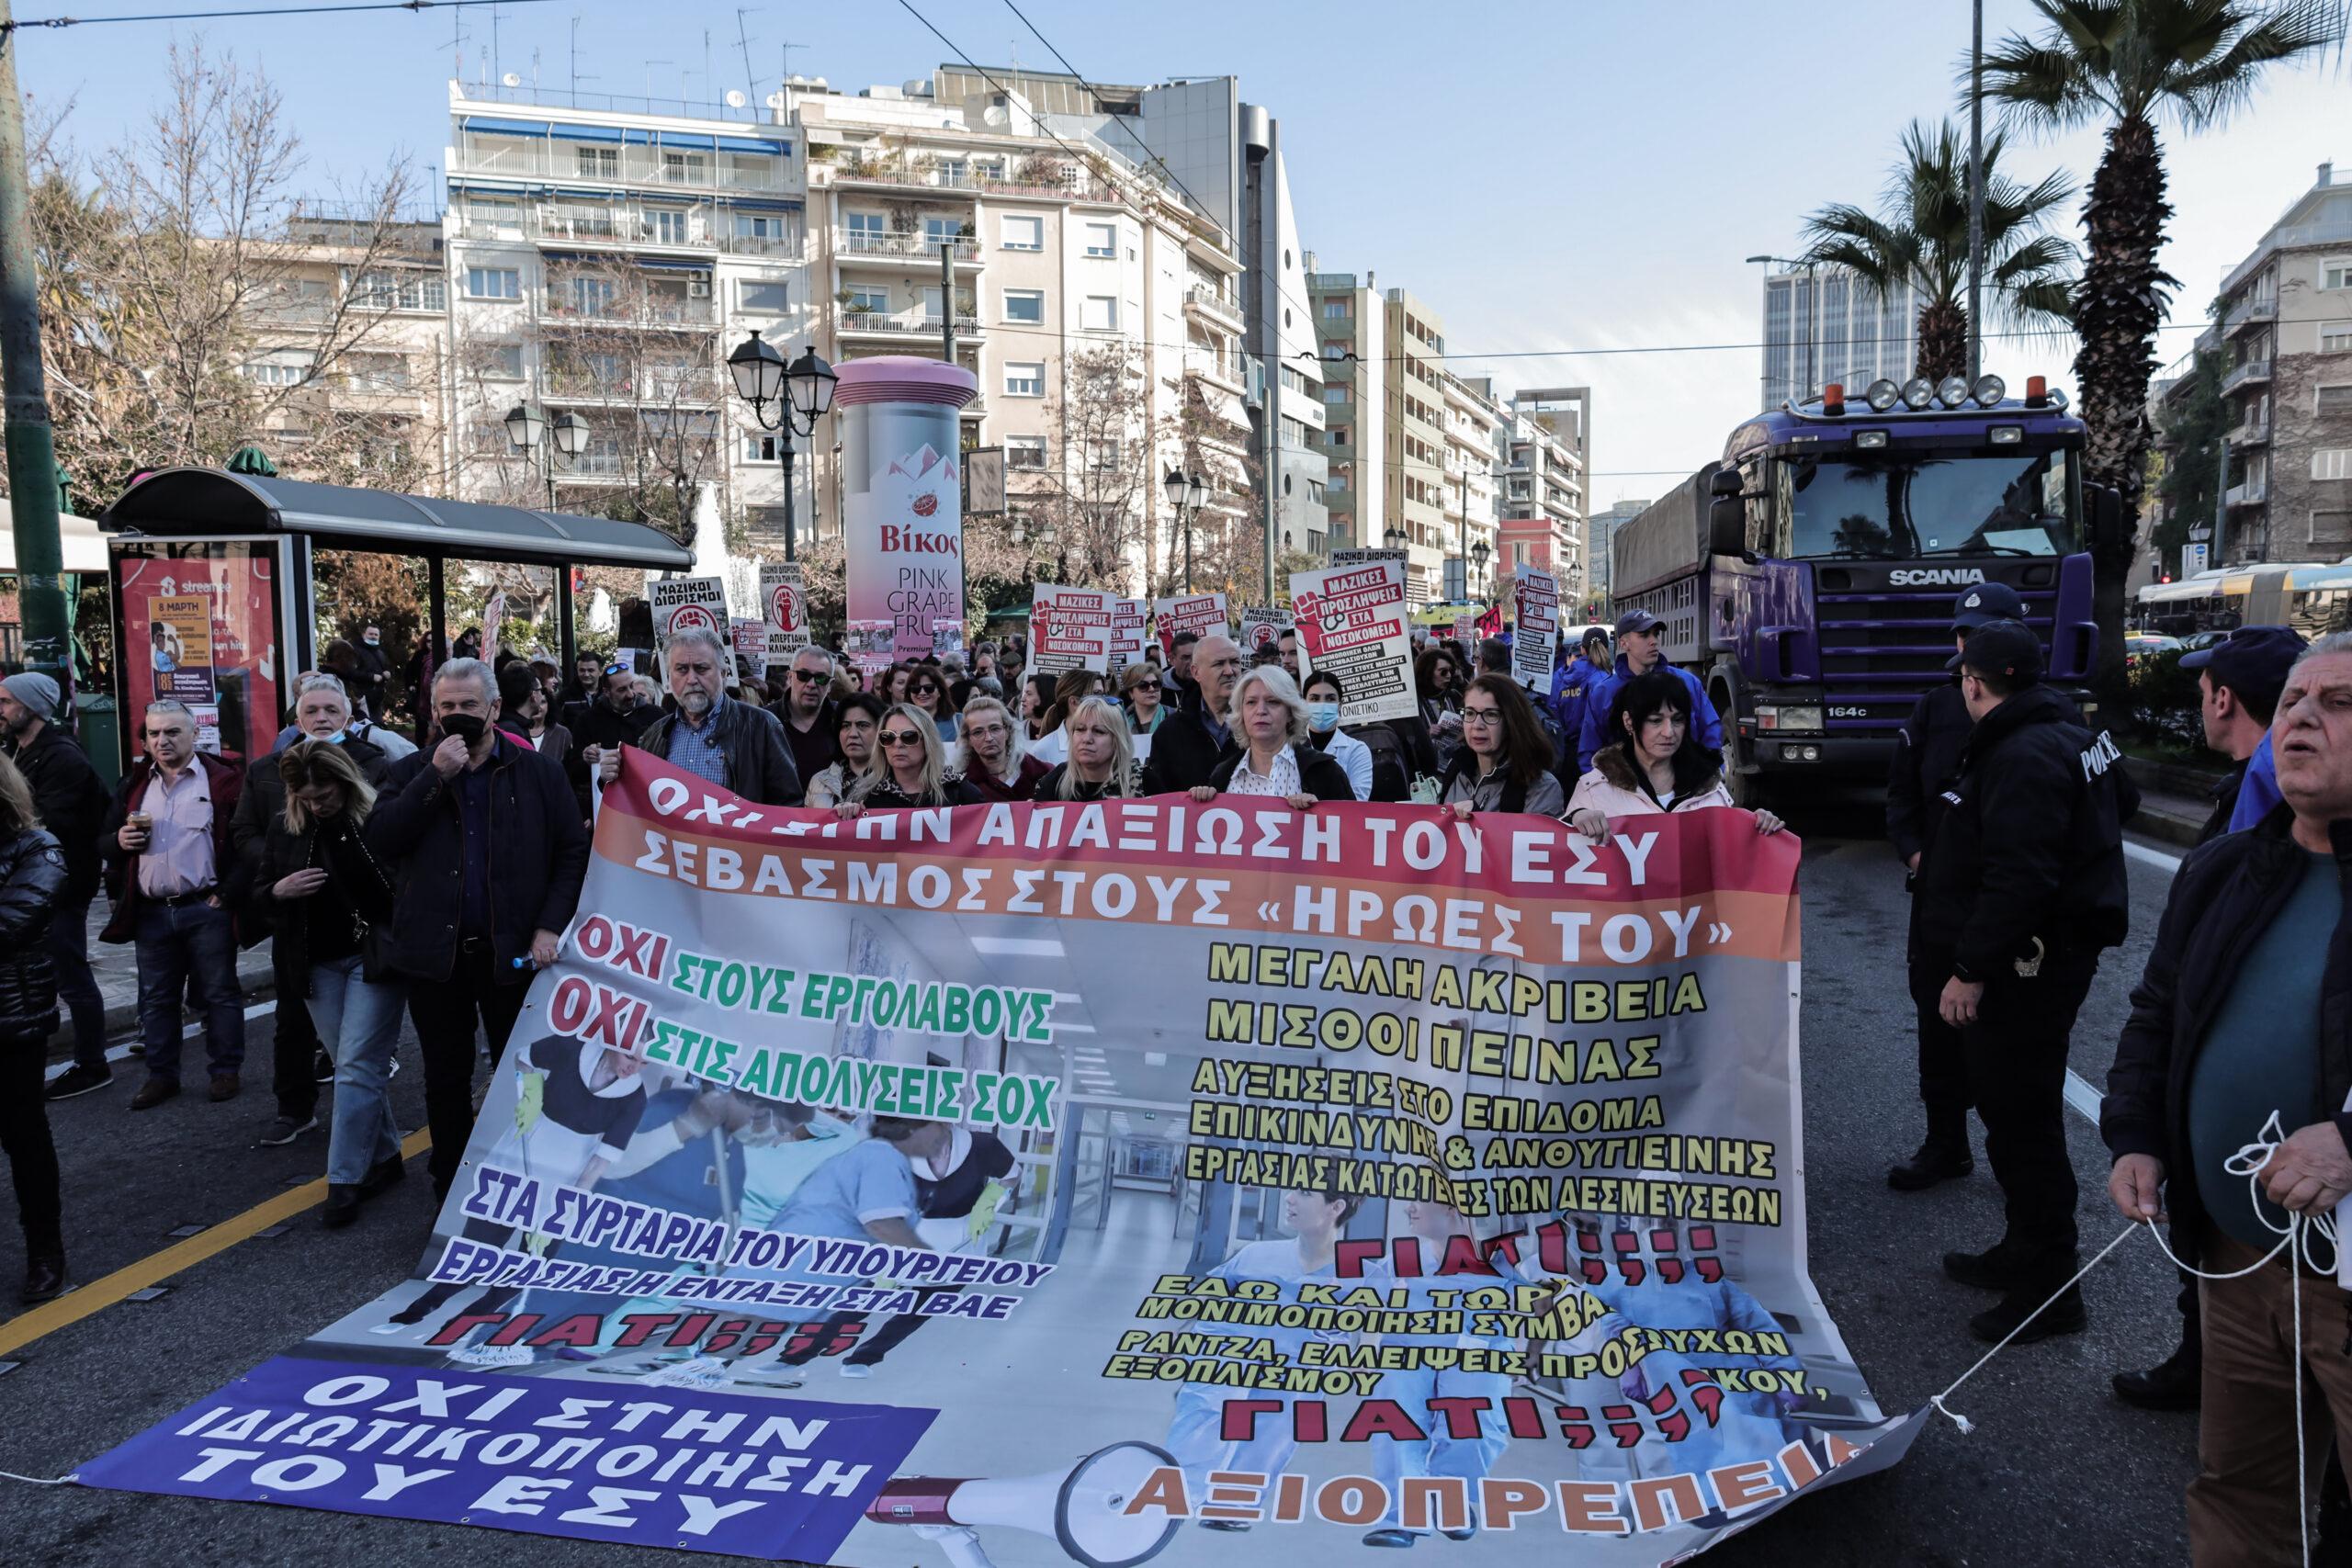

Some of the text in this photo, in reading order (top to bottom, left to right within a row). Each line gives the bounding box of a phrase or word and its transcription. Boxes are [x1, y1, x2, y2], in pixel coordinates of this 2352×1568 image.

[880, 525, 958, 559] Βίκος
[1333, 551, 1407, 561] ΜΑΖΙΚΟΙ ΔΙΟΡΙΣΜΟΙ
[658, 581, 711, 595] ΜΑΖΙΚΟΙ
[899, 567, 948, 591] PINK
[1328, 570, 1384, 594] ΜΑΖΙΚΕΣ
[1889, 568, 1986, 587] SCANIA
[159, 602, 199, 612] 8 ΜΑΡΤΗ
[654, 592, 721, 607] ΔΙΟΡΙΣΜΟΙ
[888, 591, 956, 615] GRAPE
[1058, 596, 1101, 609] ΜΑΖΙΚΕΣ
[1178, 600, 1214, 615] ΜΑΖΙΚΕΣ
[1319, 587, 1399, 616] ΠΡΟΣΛΗΨΕΙΣ
[893, 615, 953, 637] FRU
[1049, 612, 1108, 626] ΠΡΟΣΛΗΨΕΙΣ
[1172, 613, 1223, 630] ΠΡΟΣΛΗΨΕΙΣ
[1244, 615, 1287, 626] ΔΙΟΡΙΣΜΟΙ
[1248, 609, 1283, 617] ΜΑΖΙΚΟΙ
[1351, 611, 1372, 625] ΣΤΑ
[769, 634, 808, 644] ΑΠΕΡΓΙΑΚΗ
[1067, 627, 1082, 637] ΣΤΑ
[1326, 623, 1397, 649] ΝΟΣΟΚΟΜΕΙΑ
[898, 645, 933, 654] Premium
[1048, 641, 1099, 653] ΝΟΣΟΚΟΜΕΙΑ
[1828, 706, 1867, 717] 164c
[977, 803, 1341, 863] ΑΠΑΞΙΩΣΗ
[1364, 817, 1483, 874] ΤΟΥ
[1511, 830, 1660, 886] ΕΣΥ
[635, 829, 1733, 964] ΣΕΒΑΣΜΟΣ ΣΤΟΥΣ «ΗΡΩΕΣ ΤΟΥ»
[575, 915, 1056, 1042] ΟΧΙ ΣΤΟΥΣ ΕΡΓΟΛΑΒΟΥΣ
[1209, 942, 1707, 1024] ΜΕΓΑΛΗ ΑΚΡΙΒΕΙΑ
[550, 976, 1057, 1129] ΟΧΙ ΣΤΙΣ ΑΠΟΛΥΣΕΙΣ ΣΟΧ
[1206, 998, 1661, 1086] ΜΙΣΘΟΙ ΠΕΙΝΑΣ
[1192, 1057, 1665, 1134] ΑΥΞΗΣΕΙΣ ΣΤΟ ΕΠΙΔΟΜΑ
[1189, 1099, 1778, 1180] ΕΠΙΚΙΝΔΥΝΗΣ & ΑΝΘΥΓΙΕΙΝΗΣ
[1185, 1143, 1332, 1192] ΕΡΓΑΣΙΑΣ
[1492, 1175, 1554, 1216] ΤΩΝ
[1556, 1176, 1782, 1227] ΔΕΣΜΕΥΣΕΩΝ
[467, 1166, 1055, 1287] ΣΤΑ ΣΥΡΤΑΡΙΑ ΤΟΥ ΥΠΟΥΡΓΕΙΟΥ
[435, 1244, 1022, 1320] ΕΡΓΑΣΙΑΣ Η ΕΝΤΑΞΗ ΣΤΑ ΒΑΕ
[1151, 1274, 1567, 1315] ΕΔΩ ΚΑΙ ΤΩΡ
[1136, 1290, 1618, 1341] ΜΟΝΙΜΟΠΟΙΗΣΗ ΣΥΜΒΑ
[424, 1312, 869, 1358] ΓΙΑΤΙ;;;;
[1116, 1329, 1290, 1367] ΡΑΝΤΖΑ,
[1296, 1341, 1528, 1376] ΕΛΛΕΙΨΕΙΣ
[1102, 1354, 1385, 1396] ΕΞΟΠΛΙΣΜΟΥ
[302, 1374, 830, 1451] ΟΧΙ ΣΤΗΝ
[174, 1406, 874, 1499] ΙΔΙΩΤΙΚΟΠΟΙΗΣΗ
[177, 1447, 770, 1538] ΤΟΥ ΕΣΥ
